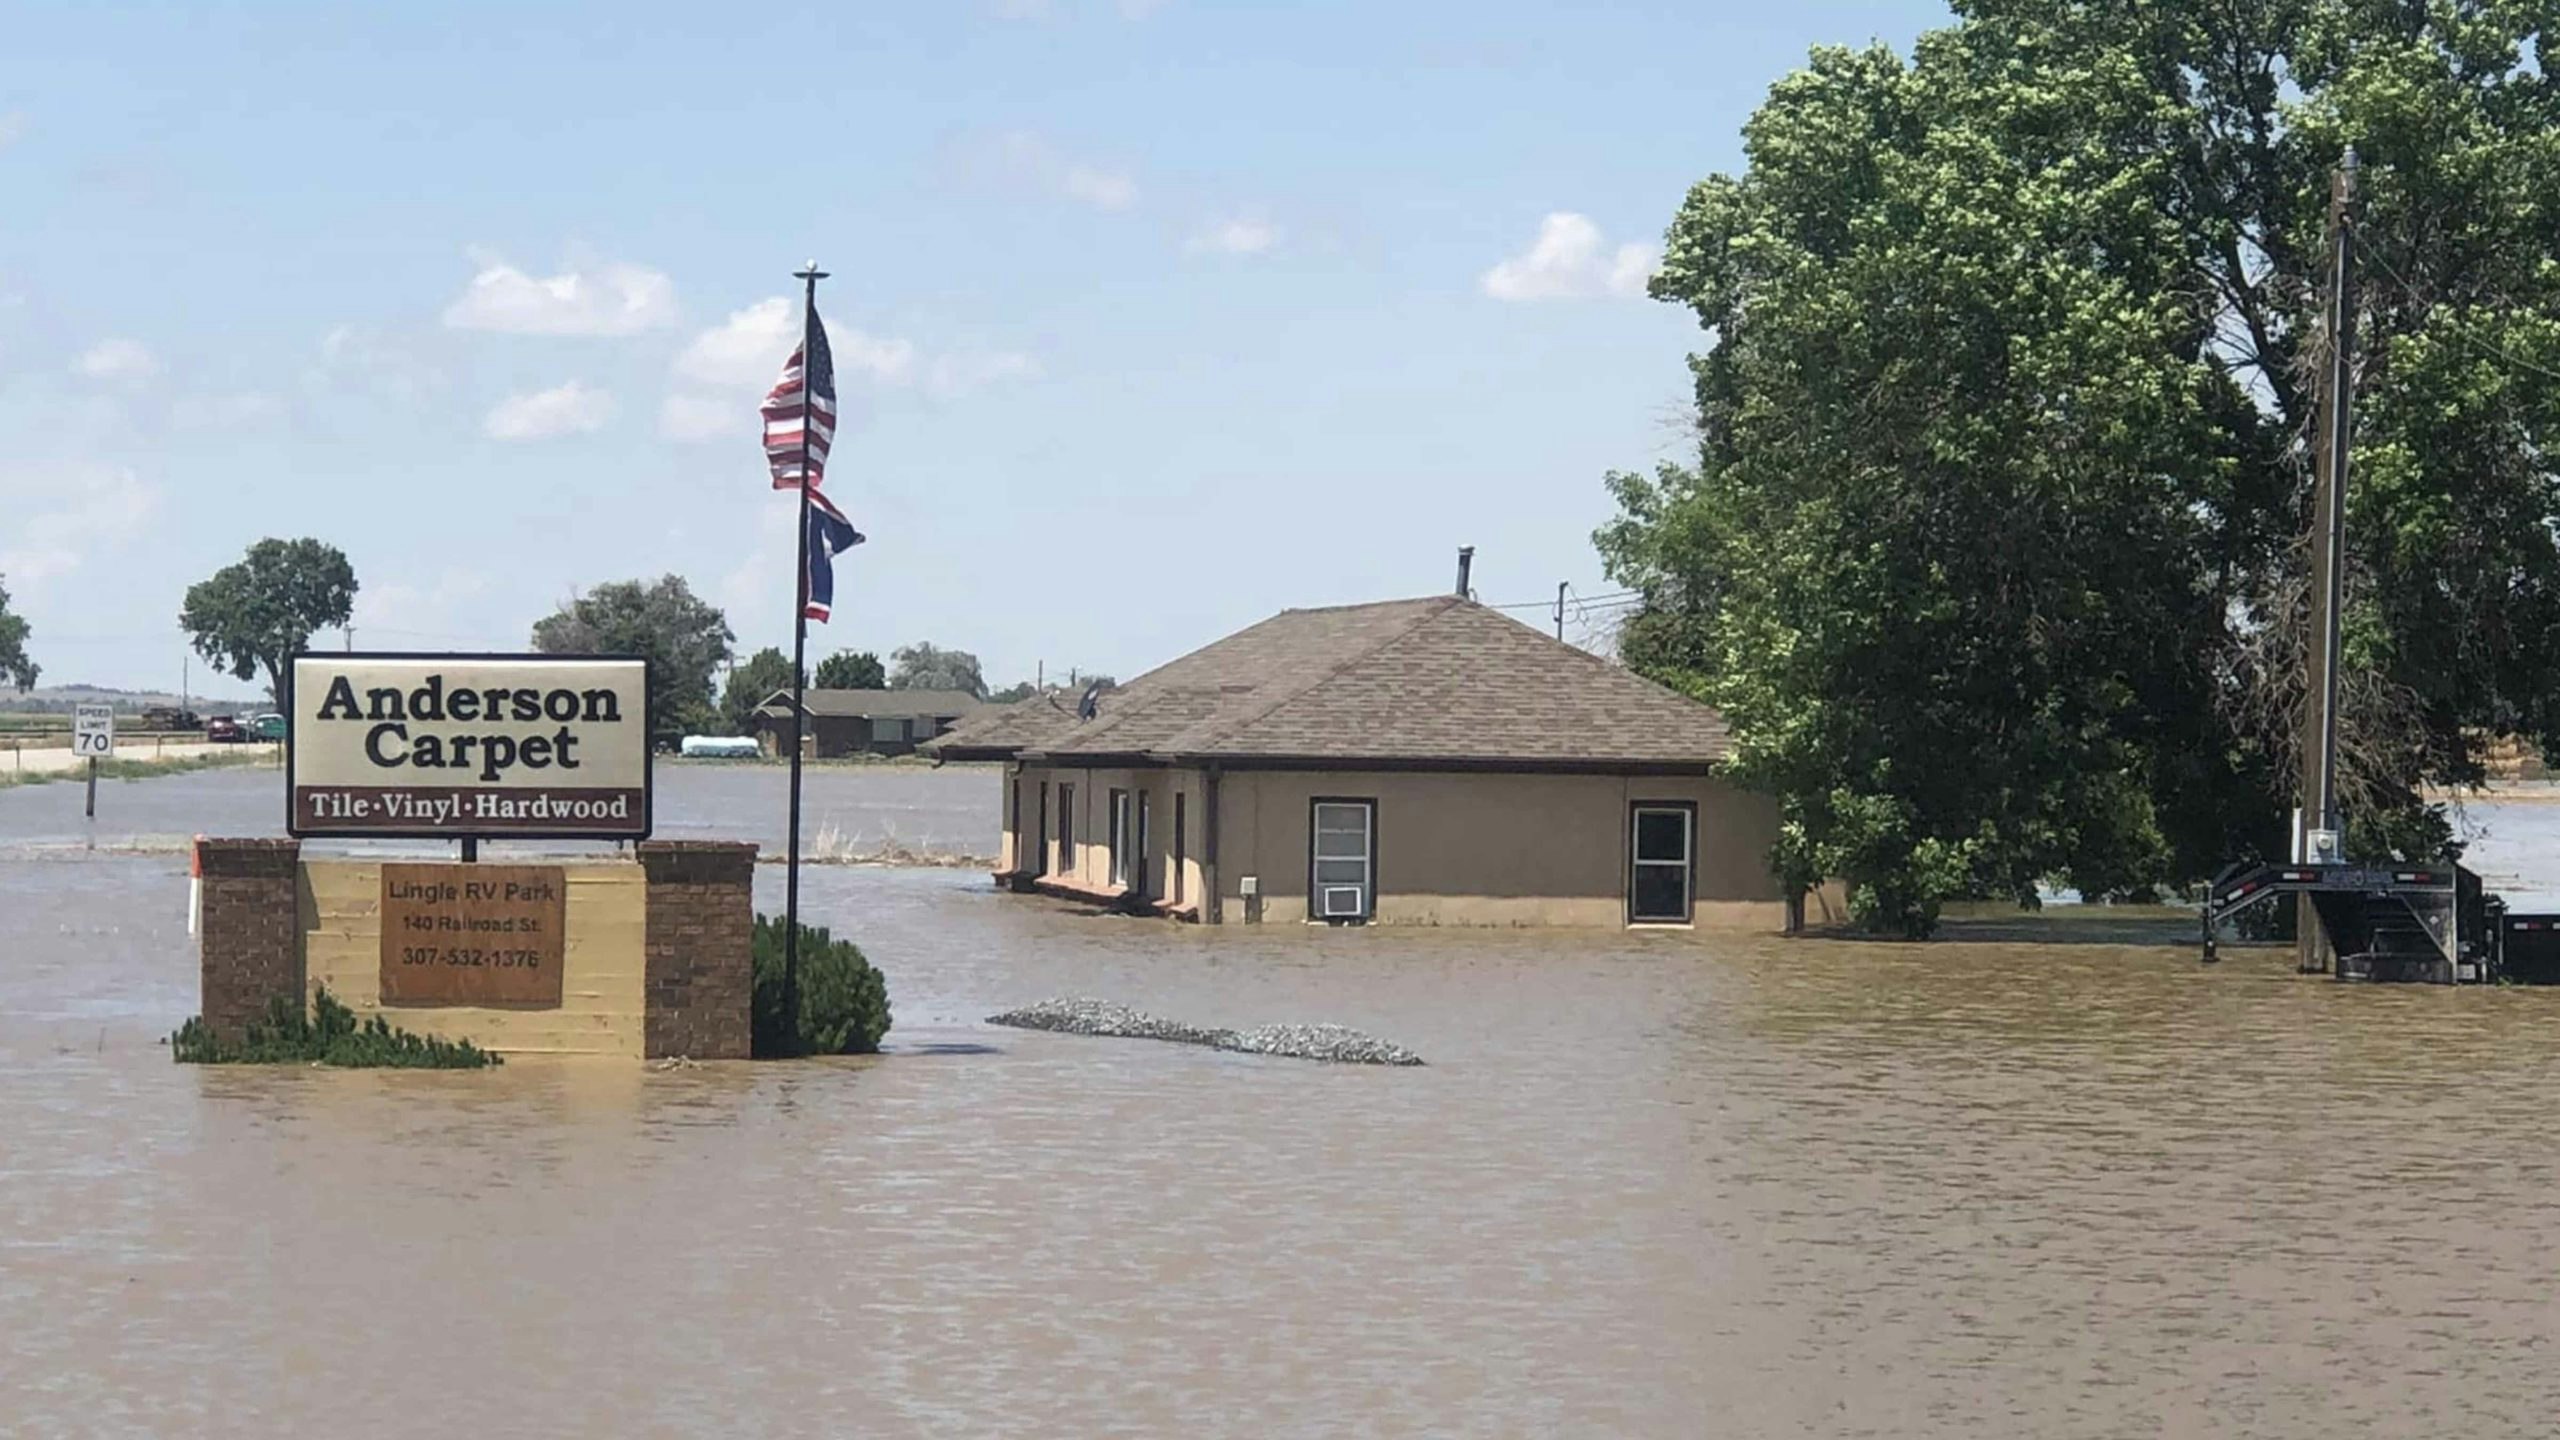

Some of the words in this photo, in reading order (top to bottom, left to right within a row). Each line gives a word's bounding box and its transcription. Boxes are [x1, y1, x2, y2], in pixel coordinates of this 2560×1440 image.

[316, 674, 622, 722] Anderson
[78, 708, 111, 718] SPEED
[78, 733, 109, 751] 70
[364, 722, 580, 781] Carpet
[389, 881, 458, 904] Lingle
[465, 882, 497, 900] RV
[505, 882, 554, 901] Park
[402, 915, 433, 931] 140
[438, 915, 513, 932] Railroad
[519, 917, 542, 932] St.
[402, 947, 540, 969] 307-532-1376
